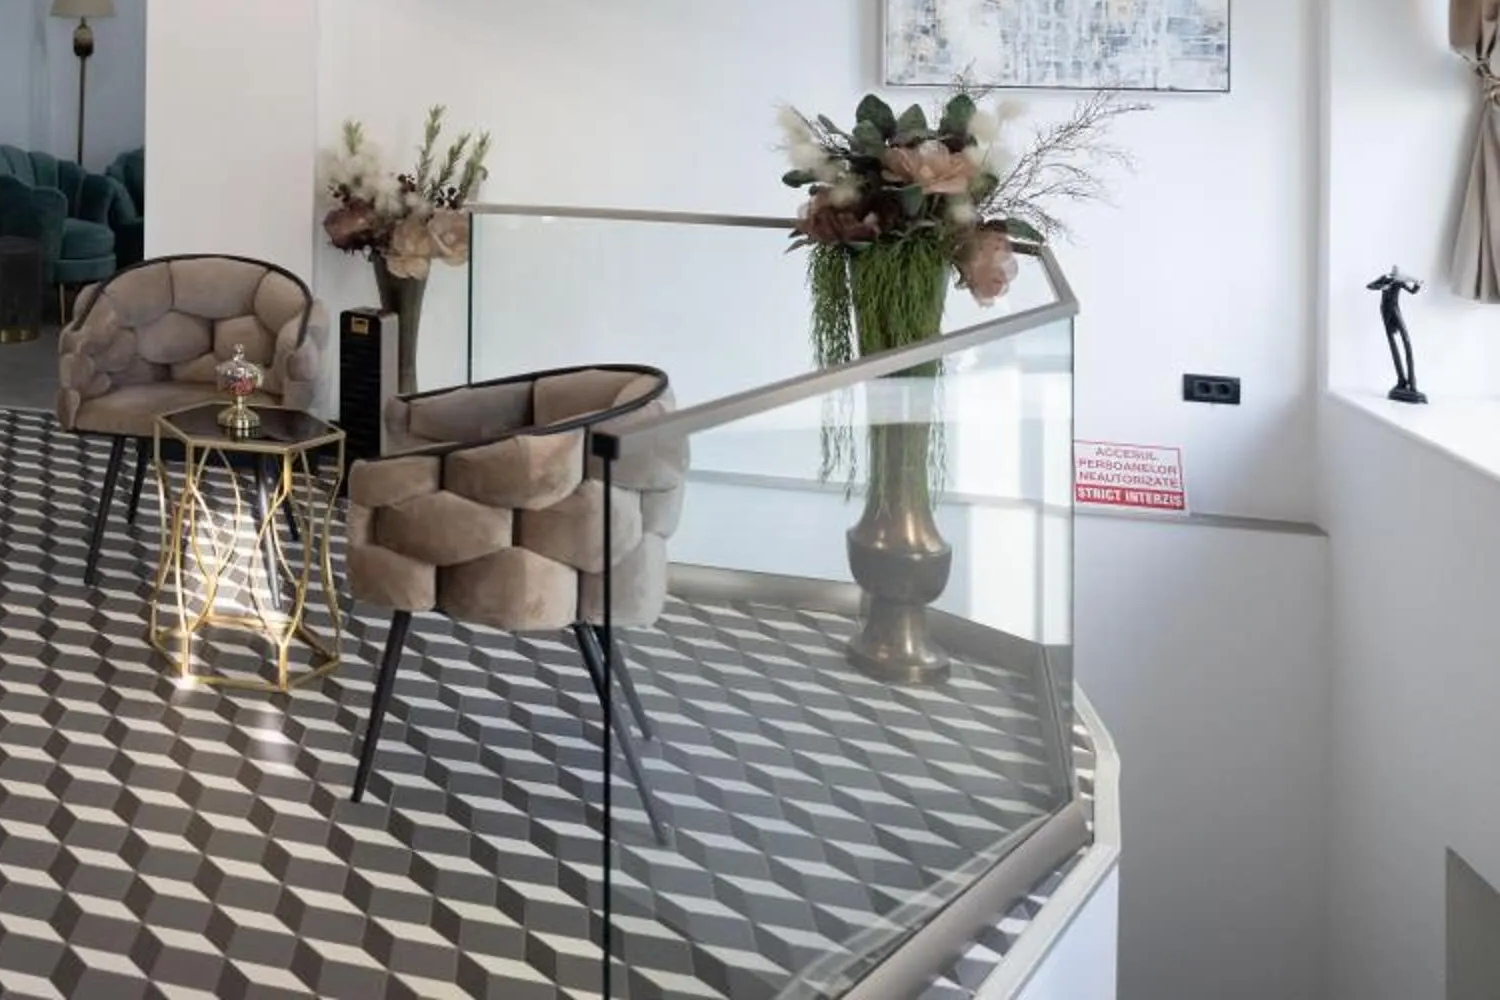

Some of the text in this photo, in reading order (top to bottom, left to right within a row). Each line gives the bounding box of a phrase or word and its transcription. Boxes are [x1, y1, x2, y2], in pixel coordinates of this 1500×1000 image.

[1096, 447, 1158, 461] ACCESUL
[1078, 458, 1177, 475] PERSOANELOR
[1079, 471, 1179, 488] NEAUTORIZATE
[1078, 487, 1182, 507] STRICT INTERZIS
